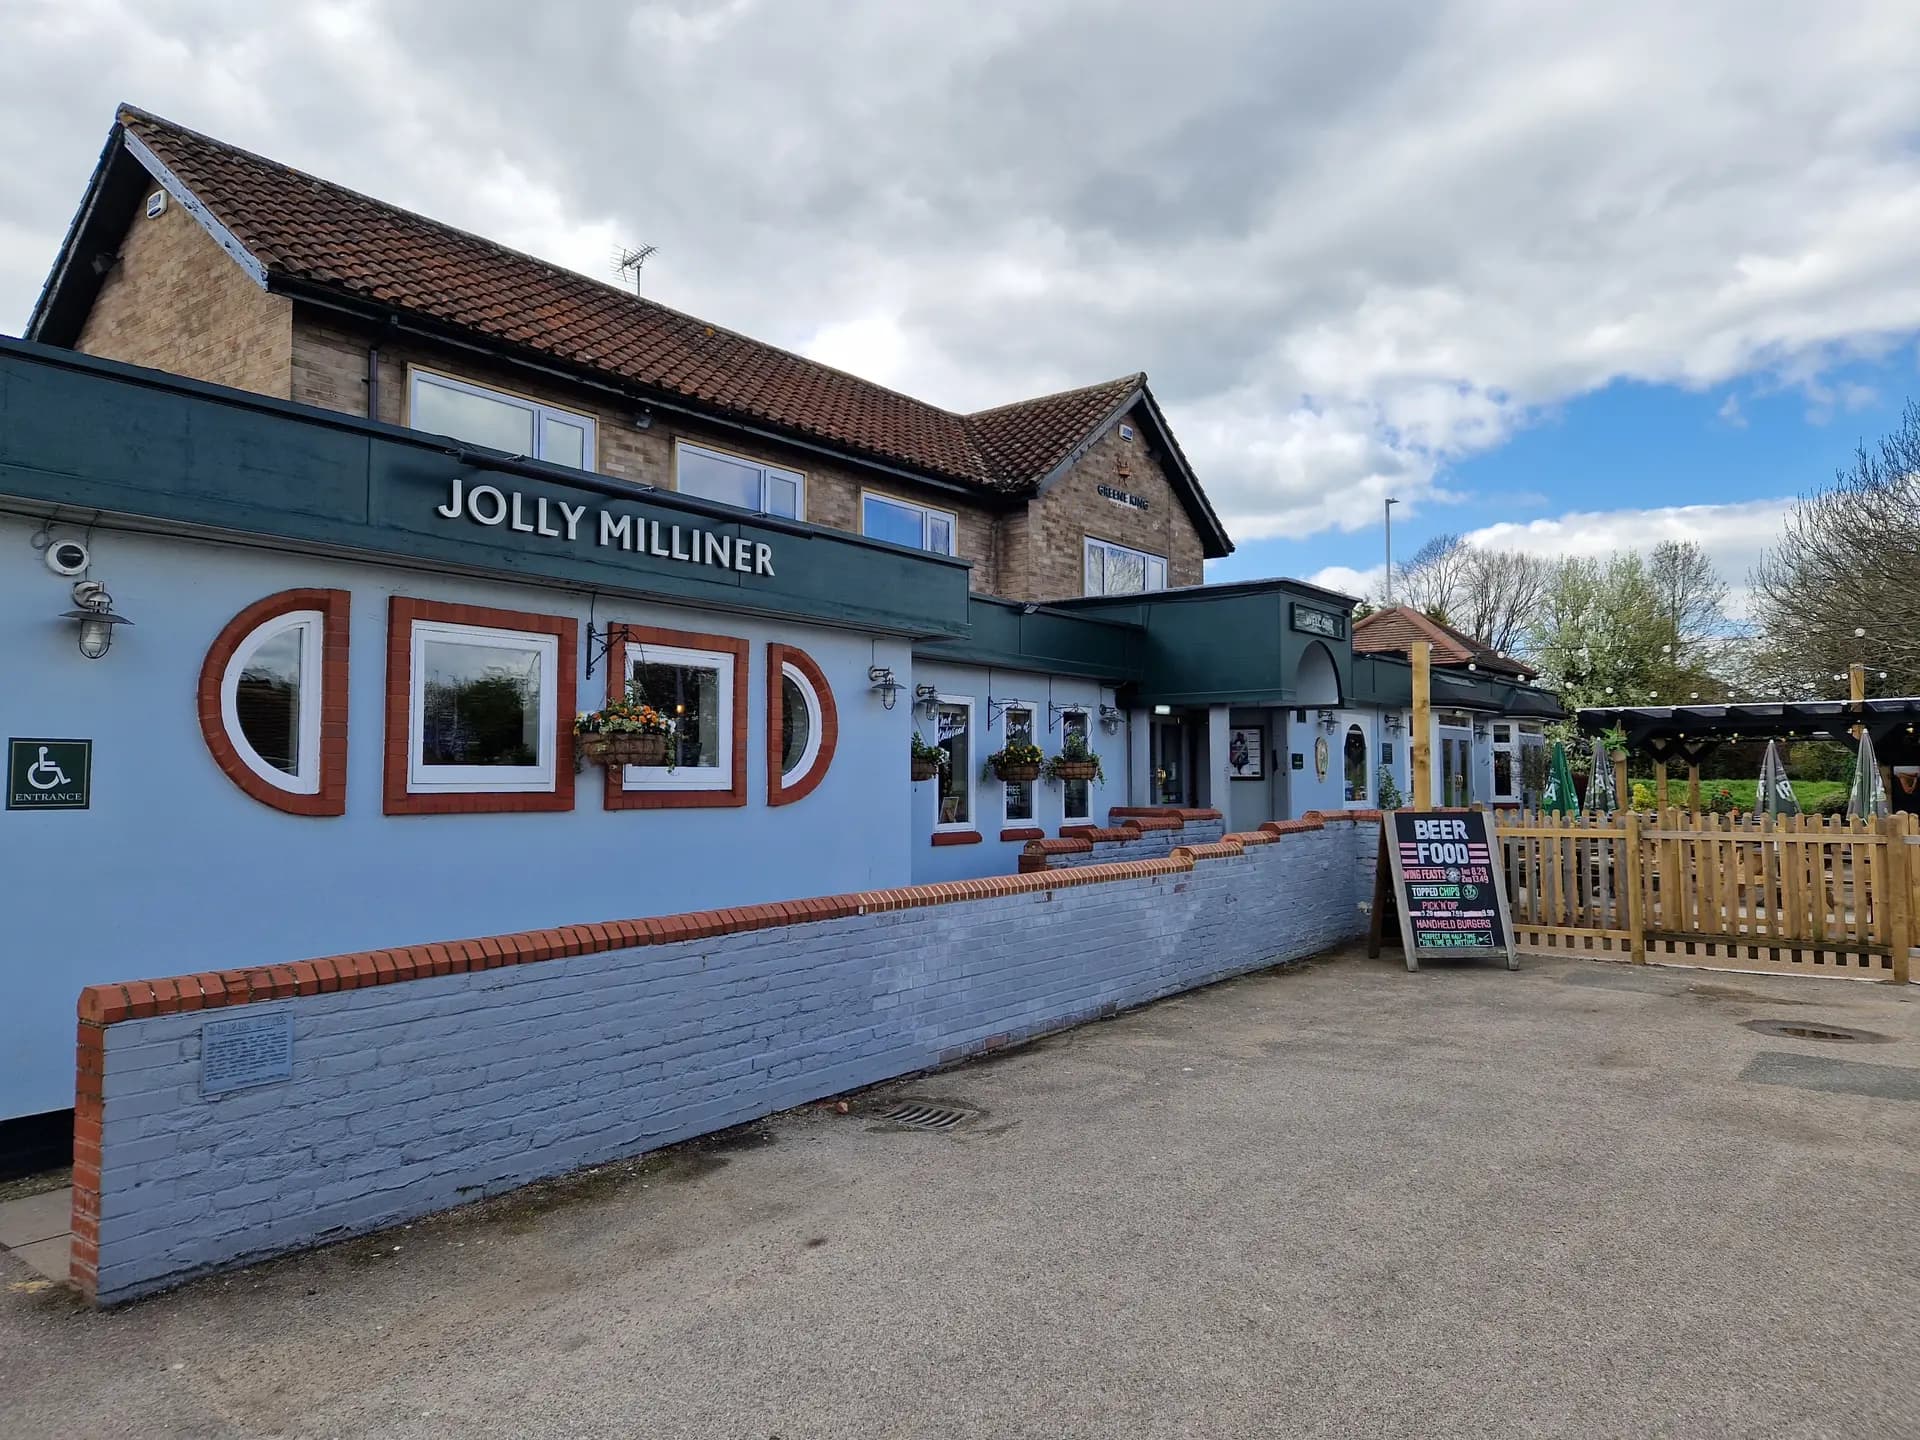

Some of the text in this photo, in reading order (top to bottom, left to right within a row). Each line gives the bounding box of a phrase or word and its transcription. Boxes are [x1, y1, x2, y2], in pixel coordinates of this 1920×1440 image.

[1097, 484, 1149, 511] GREENE KING
[437, 479, 775, 577] JOLLY MILLINER
[15, 792, 82, 801] ENTRANCE
[1414, 820, 1469, 840] BEER
[1417, 843, 1469, 864] FOOD
[1403, 869, 1421, 880] WING
[1422, 869, 1447, 880] FEASTS
[1412, 887, 1460, 897] TOPPED CHIPS
[1416, 920, 1491, 929] HANDHELD BURGERS
